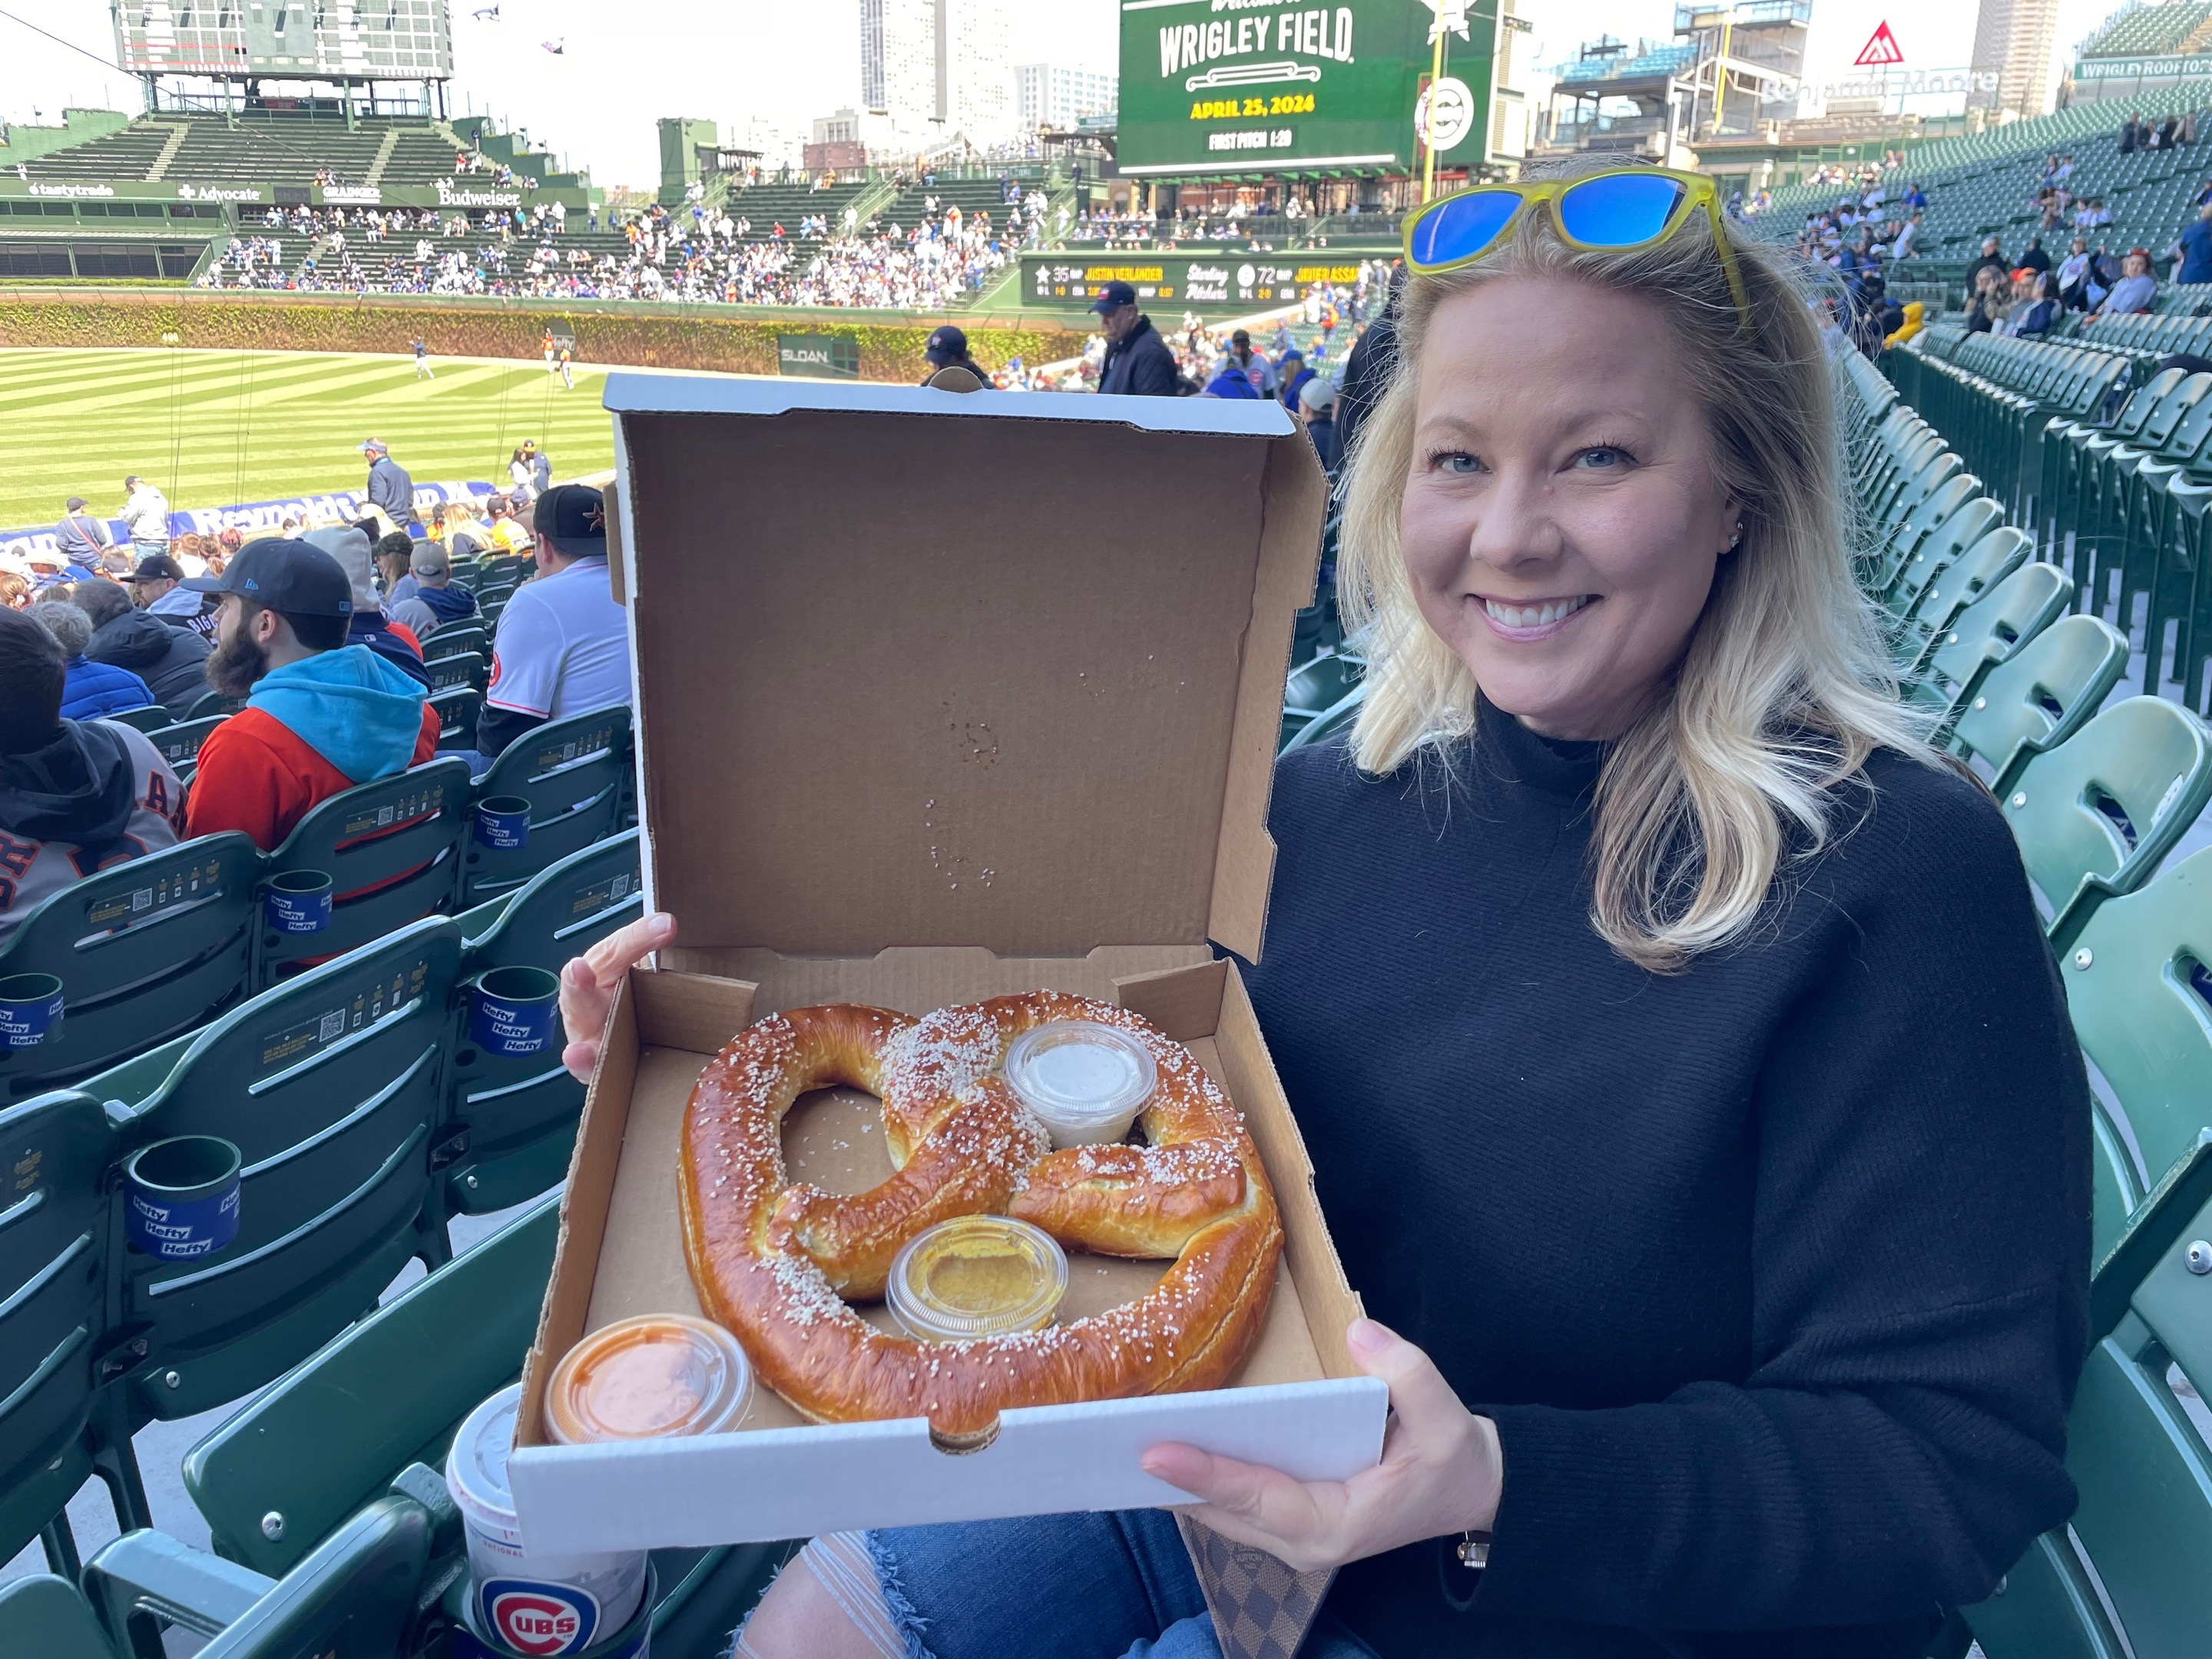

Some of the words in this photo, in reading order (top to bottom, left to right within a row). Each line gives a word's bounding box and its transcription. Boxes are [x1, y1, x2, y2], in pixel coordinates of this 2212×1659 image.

[1160, 15, 1271, 78] WRIGLEY
[1278, 7, 1353, 63] FIELD
[2082, 62, 2142, 78] WRIGLEY
[1760, 76, 1887, 105] Benjamin
[1902, 70, 1999, 93] Moore
[1190, 101, 1240, 119] APRIL
[1243, 98, 1268, 118] 25,
[1270, 94, 1315, 114] 2024
[1209, 134, 1237, 150] FIRST
[1237, 131, 1267, 149] PITCH
[1270, 129, 1292, 147] 1:20
[39, 184, 114, 197] tastytrade
[198, 186, 260, 200] Advocate
[438, 188, 520, 206] Budweiser
[1053, 267, 1069, 282] 35
[1084, 267, 1114, 282] JUSTIN
[1114, 266, 1163, 281] VERLANDER
[1257, 266, 1275, 284] 72
[780, 349, 828, 363] SLOAN
[187, 495, 359, 535] Reynolds
[280, 910, 303, 920] Hefty
[484, 1004, 513, 1022] Hefty
[0, 1022, 27, 1034] Hefty
[494, 1024, 528, 1037] Hefty
[506, 1040, 540, 1049] Hefty
[134, 1197, 166, 1221] Hefty
[147, 1223, 188, 1239] Hefty
[164, 1242, 210, 1253] Hefty
[482, 1539, 524, 1558] NATIONAL
[496, 1596, 576, 1656] CUBS
